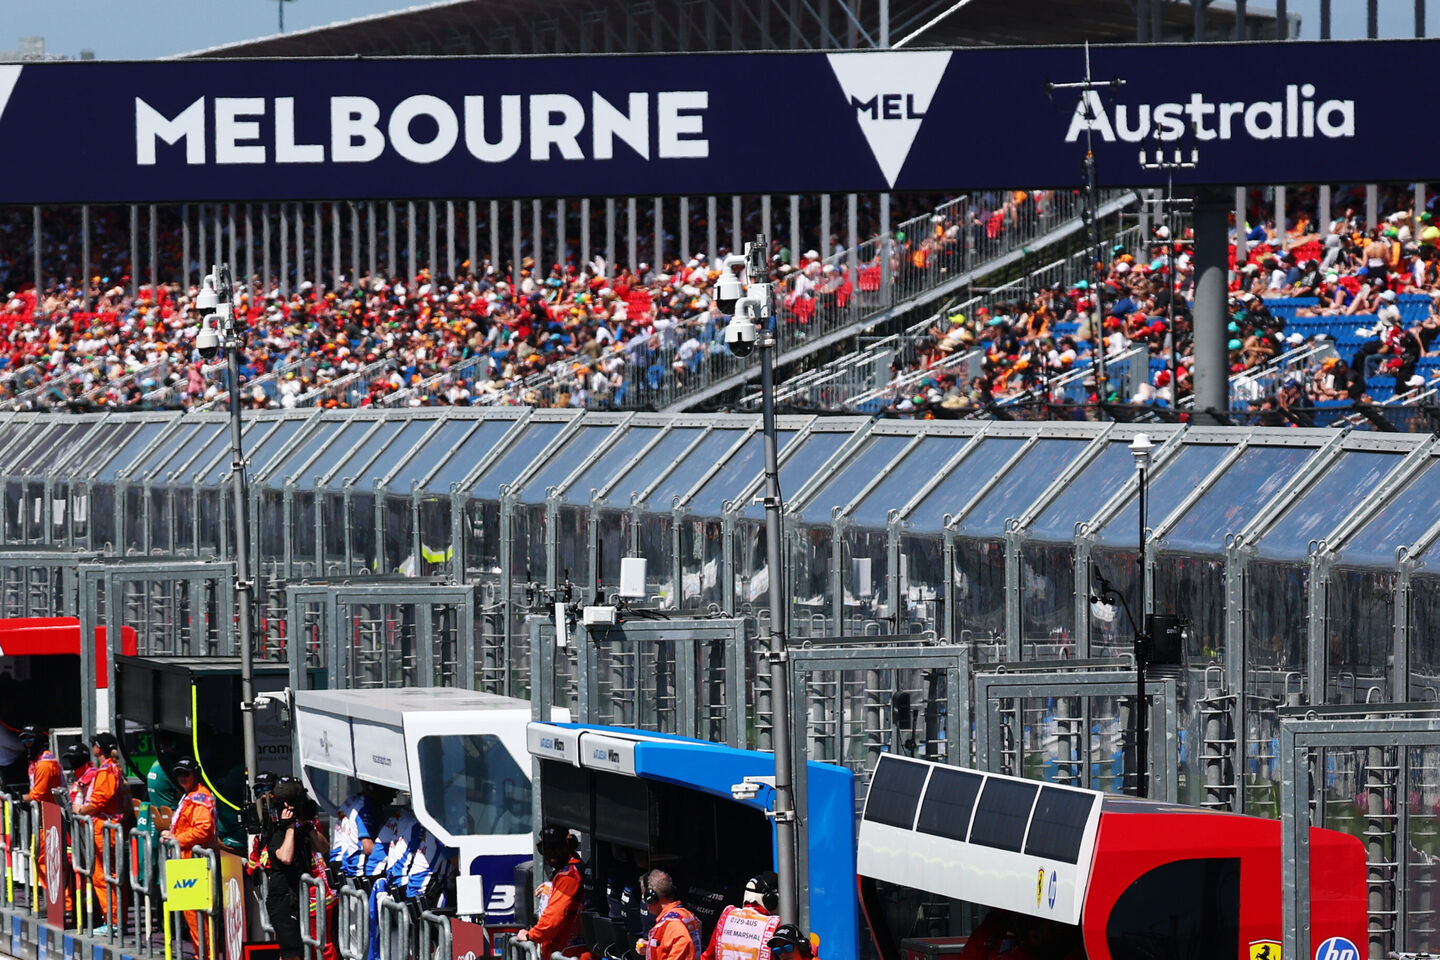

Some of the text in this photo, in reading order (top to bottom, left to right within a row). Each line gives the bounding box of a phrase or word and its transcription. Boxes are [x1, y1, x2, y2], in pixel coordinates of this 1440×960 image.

[135, 90, 709, 166] MELBOURNE
[851, 93, 925, 121] MEL
[1065, 83, 1355, 142] Australia
